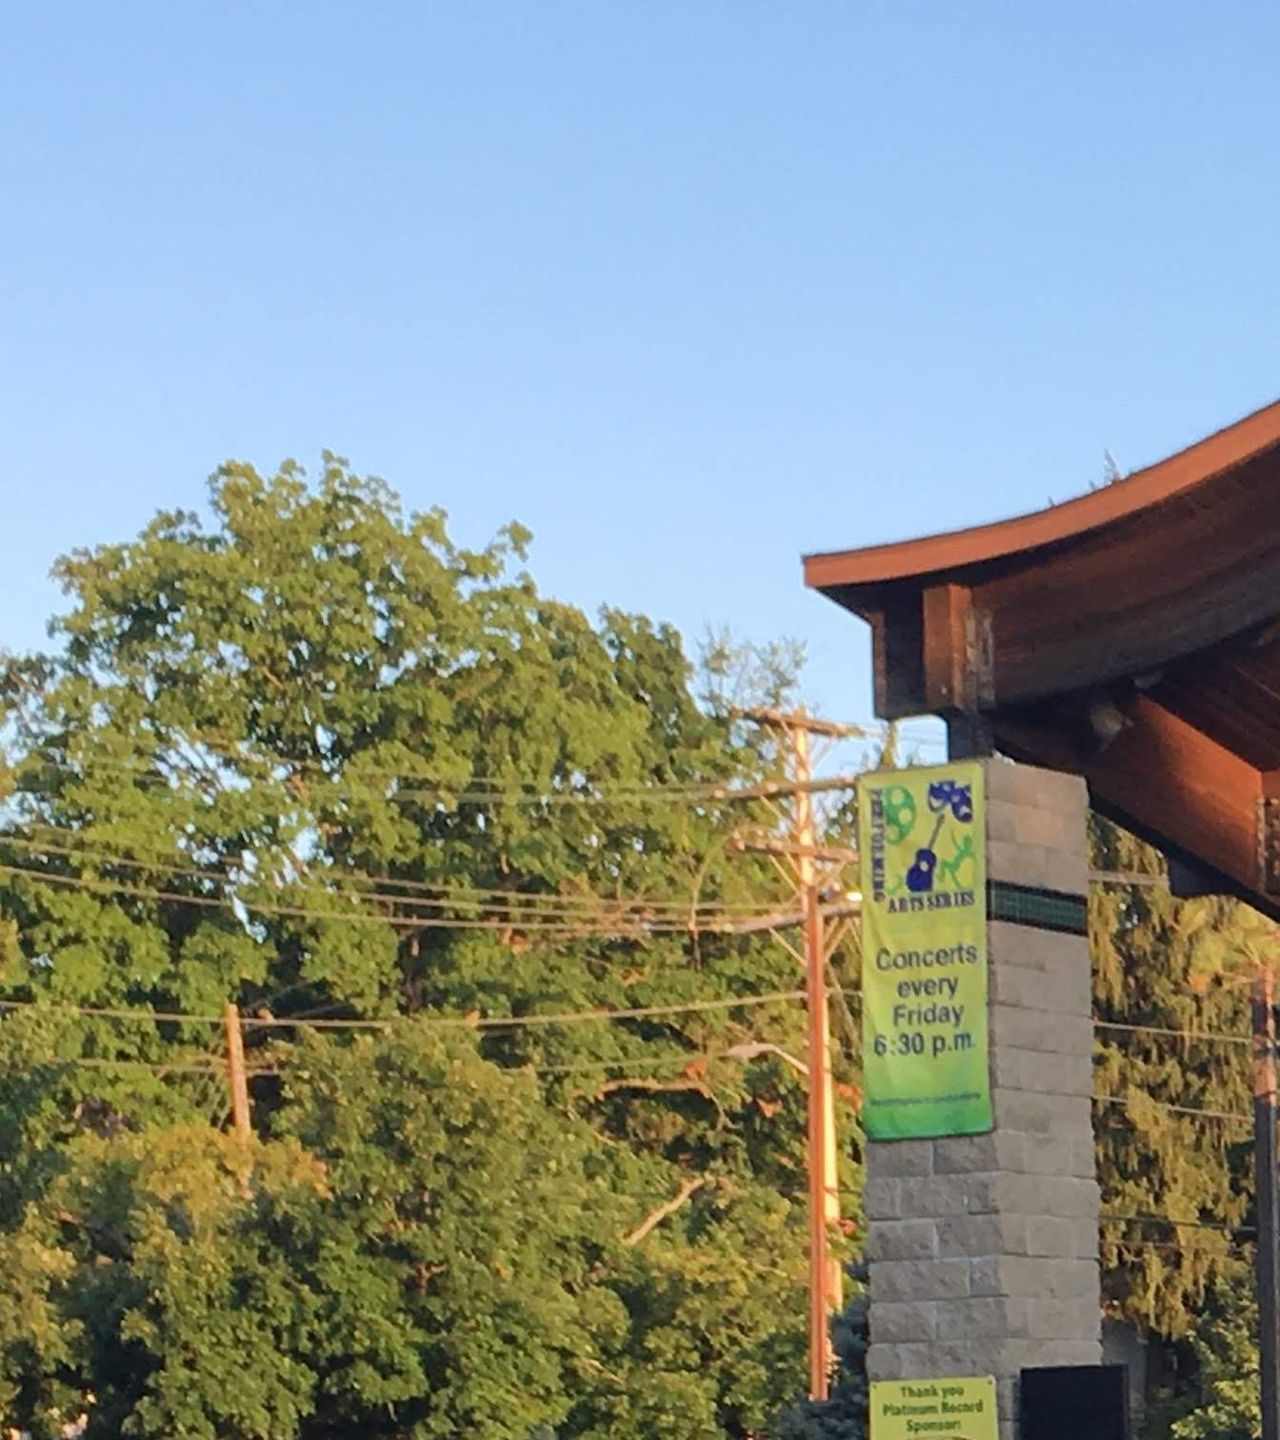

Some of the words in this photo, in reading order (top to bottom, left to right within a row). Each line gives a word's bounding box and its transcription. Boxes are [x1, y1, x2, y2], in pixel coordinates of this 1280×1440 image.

[887, 896, 924, 914] ARTS
[927, 890, 975, 911] SERIES
[876, 943, 977, 971] Concerts
[897, 977, 958, 999] every
[893, 1002, 964, 1027] Friday
[874, 1032, 924, 1057] 6:30
[901, 1384, 938, 1397] Thank
[941, 1387, 964, 1399] you
[941, 1399, 983, 1413] Record
